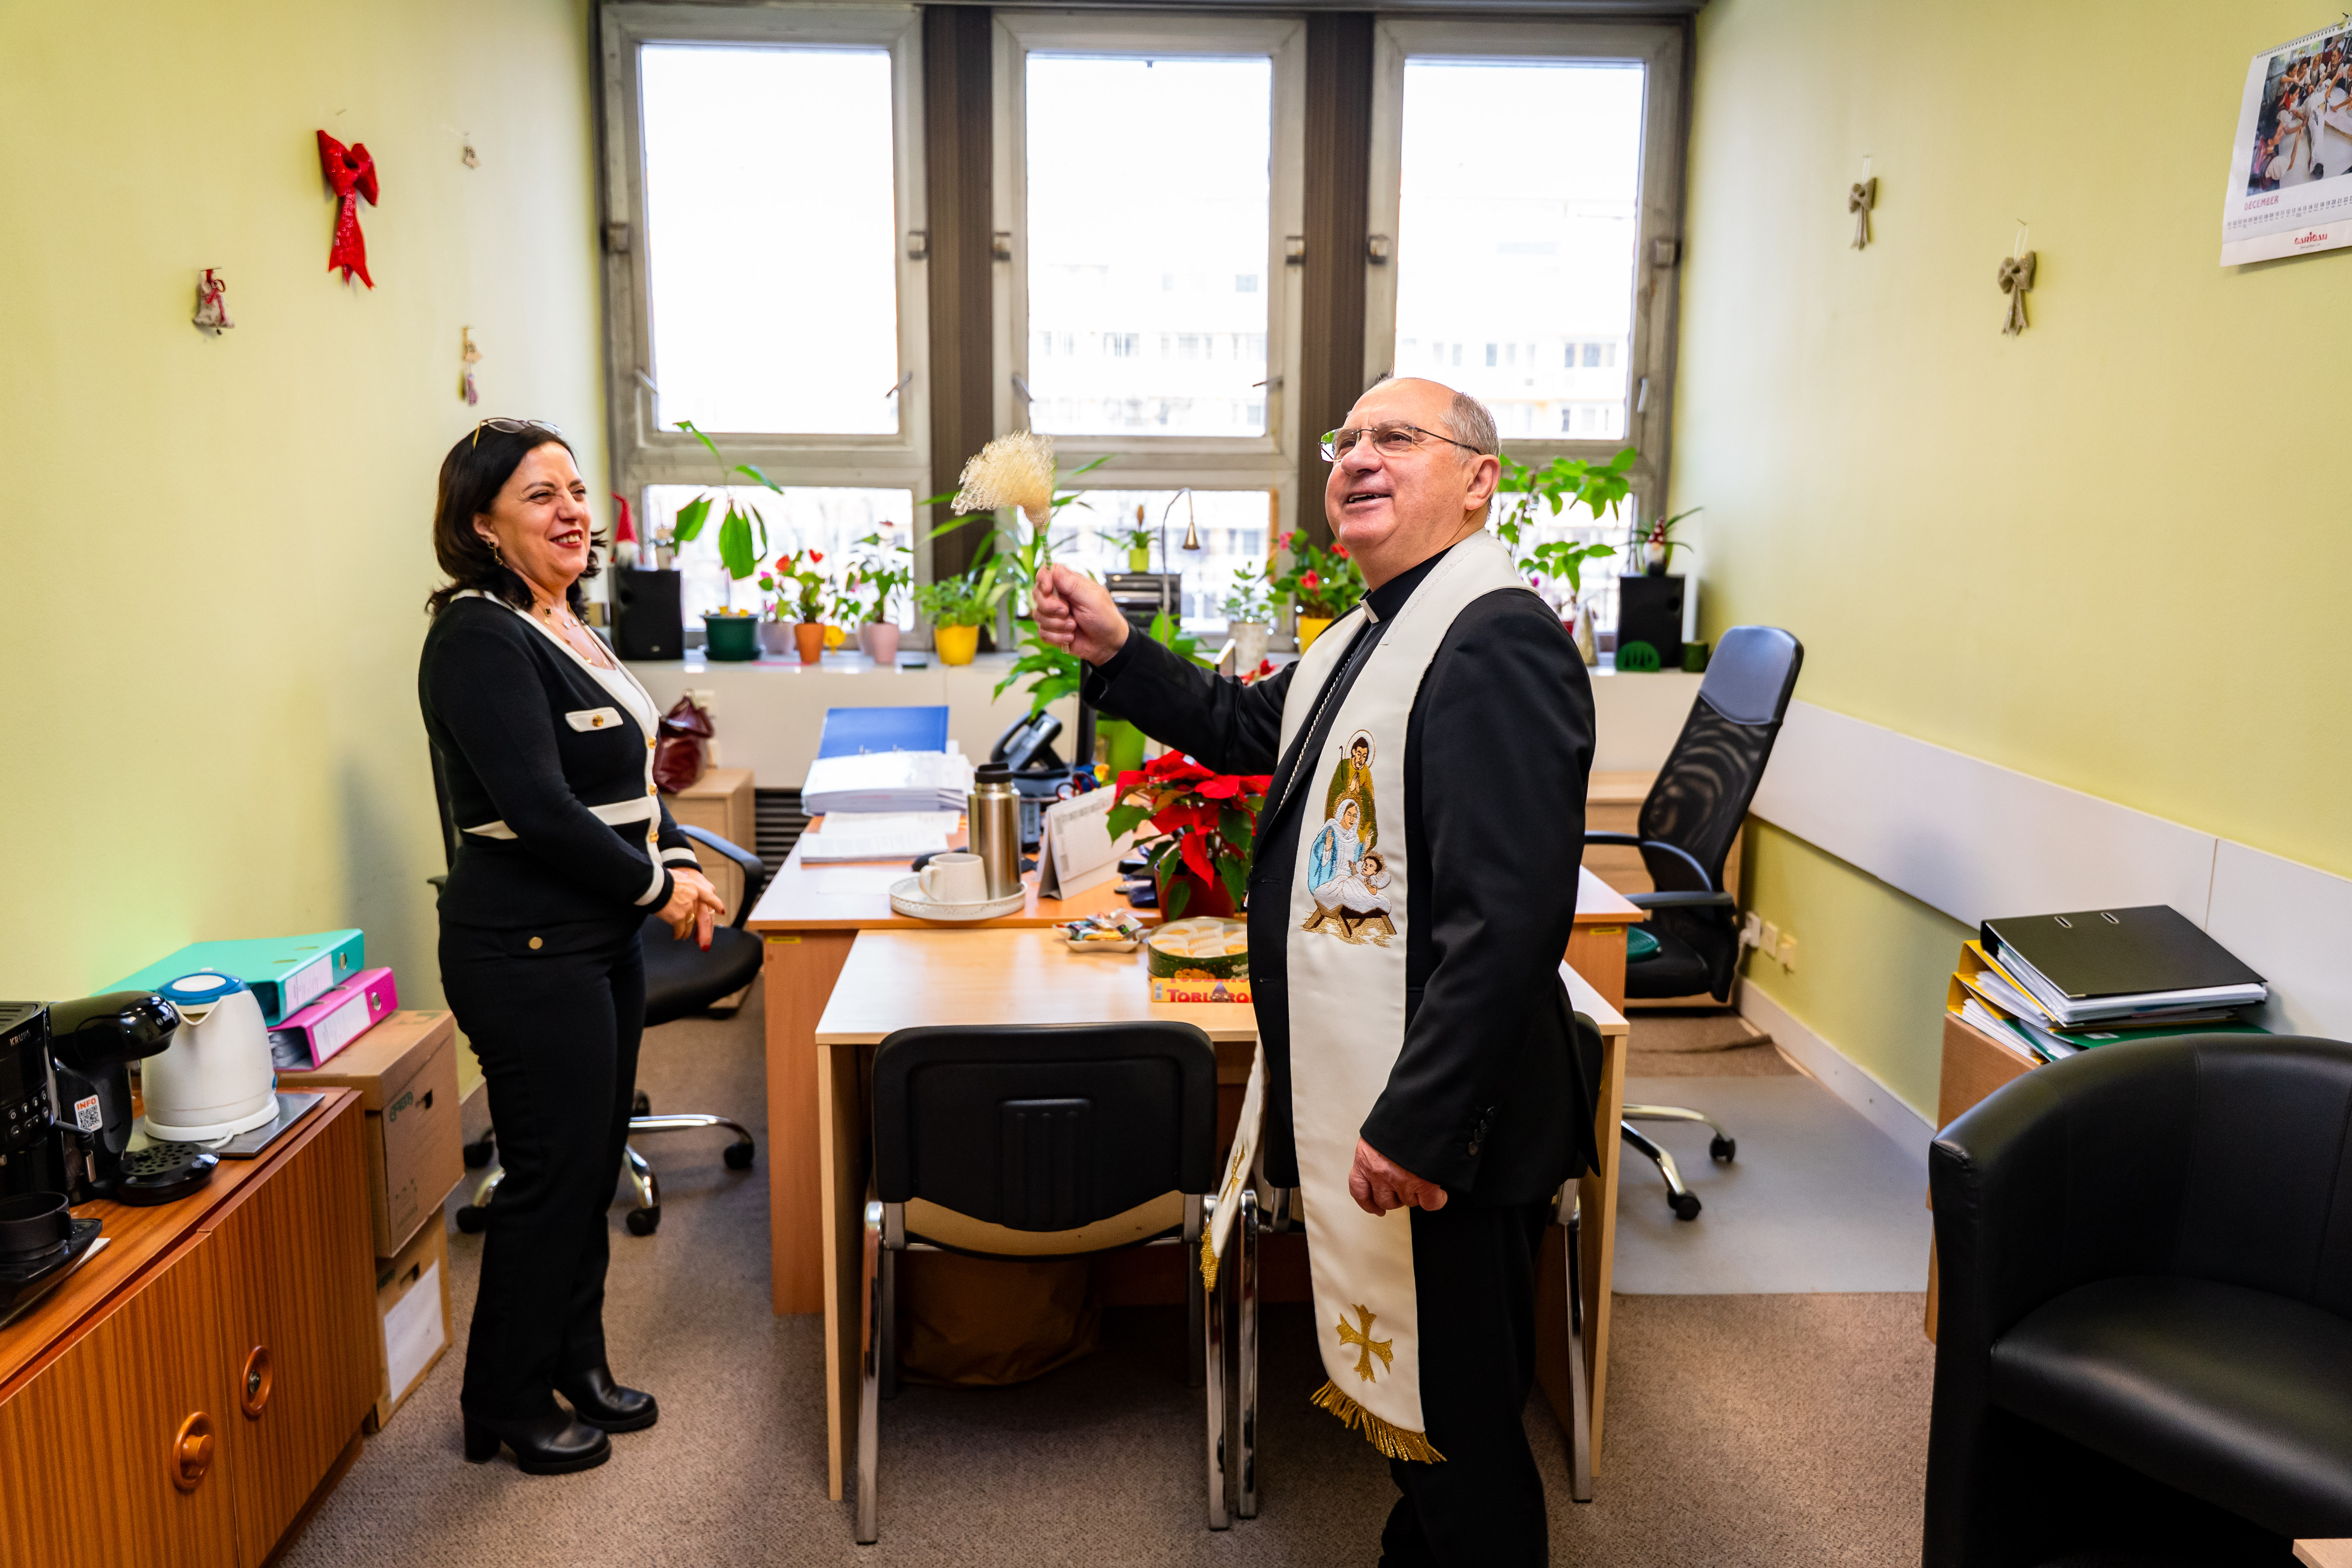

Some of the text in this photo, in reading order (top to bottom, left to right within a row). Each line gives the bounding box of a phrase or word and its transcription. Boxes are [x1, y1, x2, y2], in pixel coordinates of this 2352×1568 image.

[2244, 196, 2279, 211] DECEMBER
[10, 1029, 31, 1046] KRUPS
[76, 1098, 96, 1111] INFO
